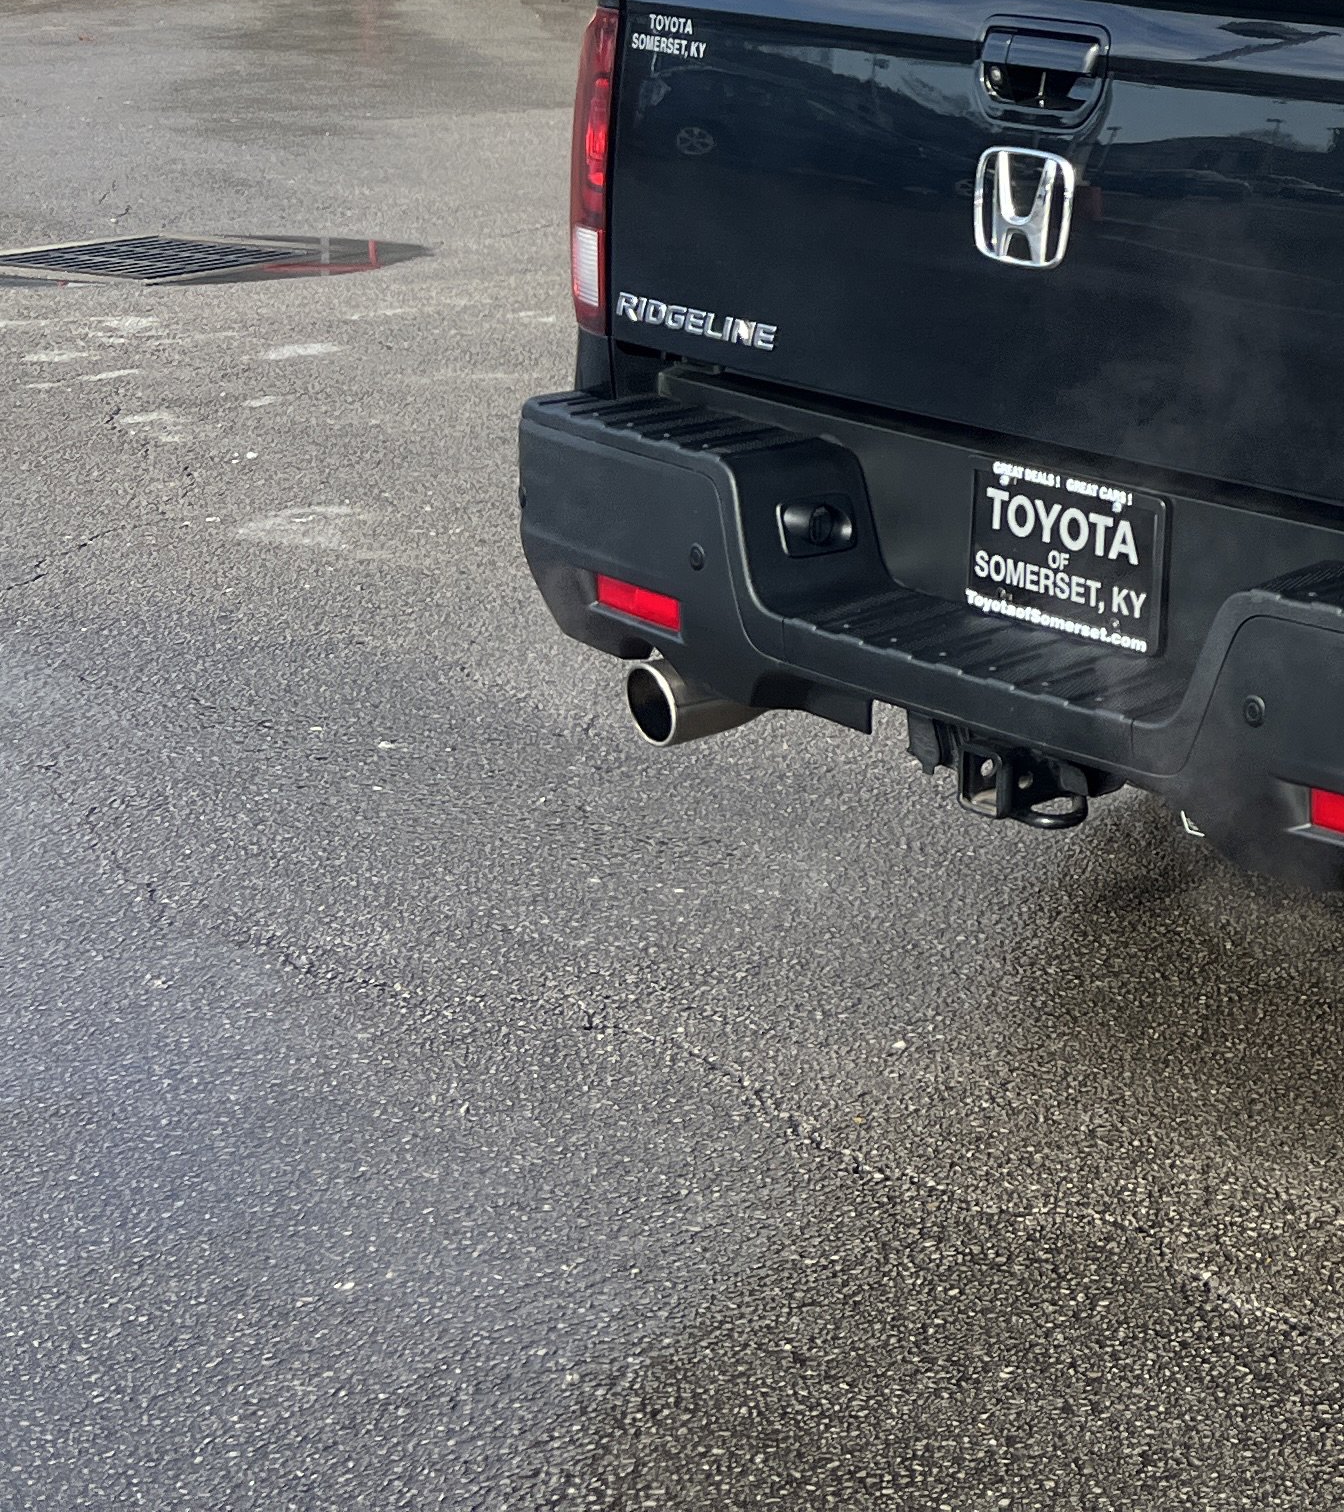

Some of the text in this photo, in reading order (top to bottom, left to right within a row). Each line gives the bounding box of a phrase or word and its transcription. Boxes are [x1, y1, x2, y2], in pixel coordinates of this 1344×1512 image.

[631, 32, 707, 59] SOMERSET, KY
[649, 13, 693, 35] TOYOTA
[616, 291, 778, 351] RIDGELINE
[992, 461, 1025, 479] GREAT
[1065, 478, 1099, 497] GREAT
[986, 487, 1139, 566] TOYOTA
[1047, 549, 1070, 571] OF
[973, 550, 1147, 619] SOMERSET, KY
[964, 587, 1148, 653] ToyotaofSomerset.com
